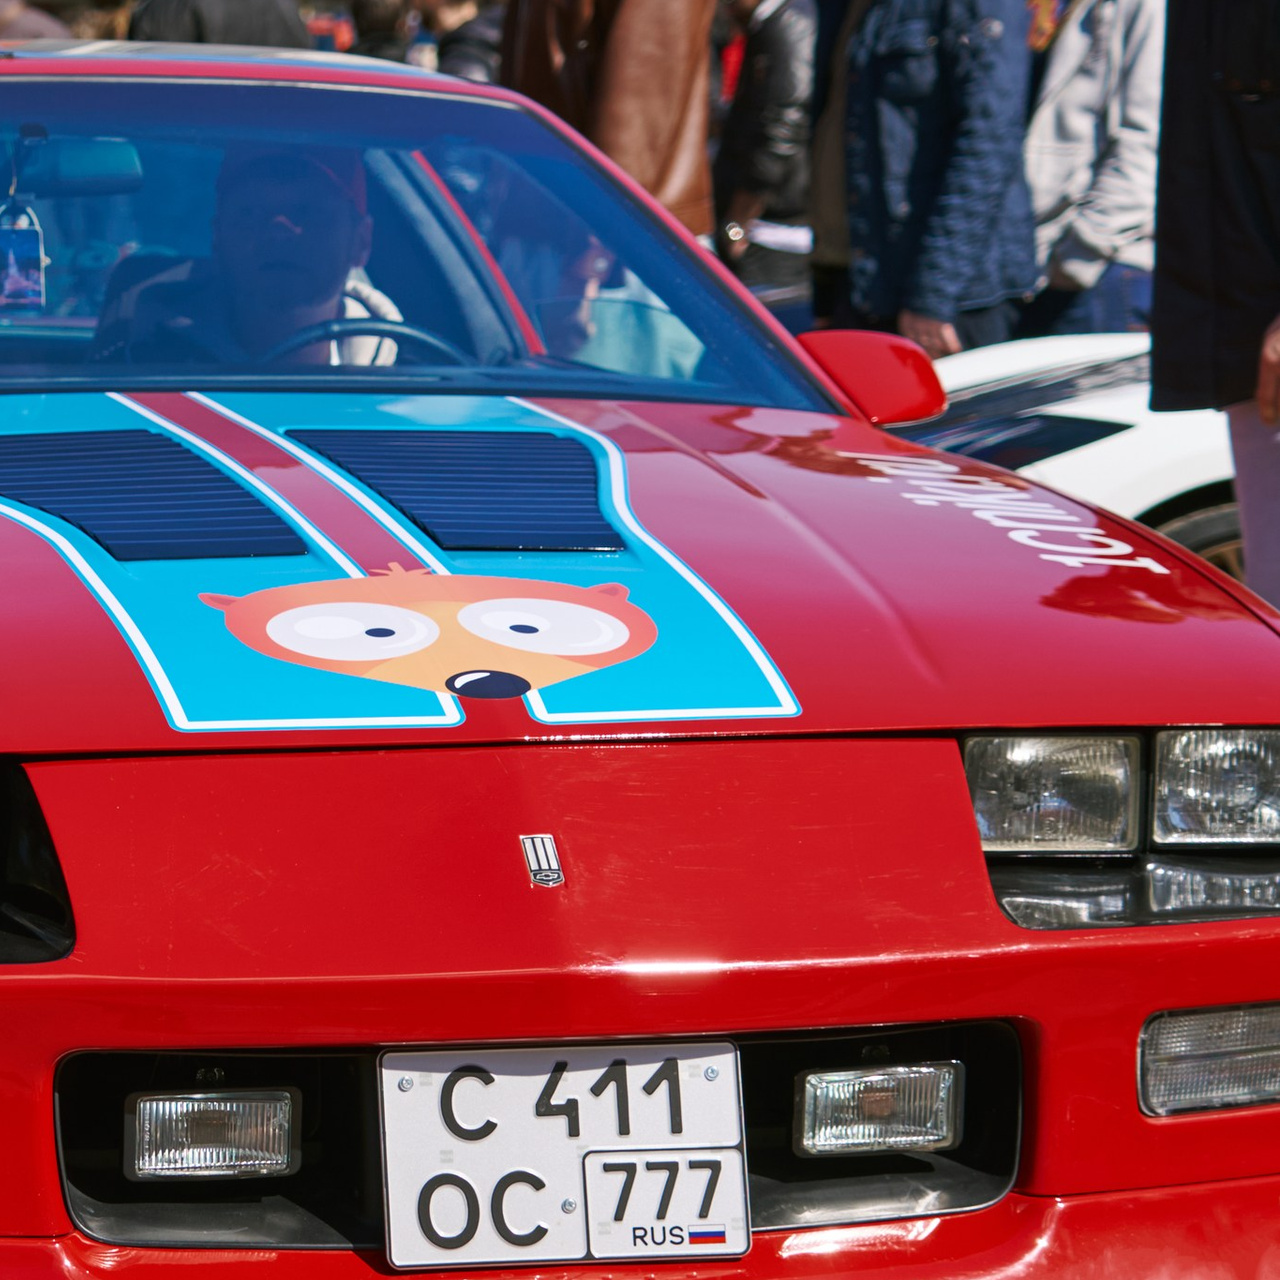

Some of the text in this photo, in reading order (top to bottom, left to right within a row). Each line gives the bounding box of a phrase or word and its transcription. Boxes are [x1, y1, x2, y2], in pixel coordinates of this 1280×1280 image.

[439, 1057, 684, 1142] C 411
[417, 1170, 549, 1250] OC
[602, 1159, 722, 1222] 777
[632, 1224, 685, 1247] RUS
